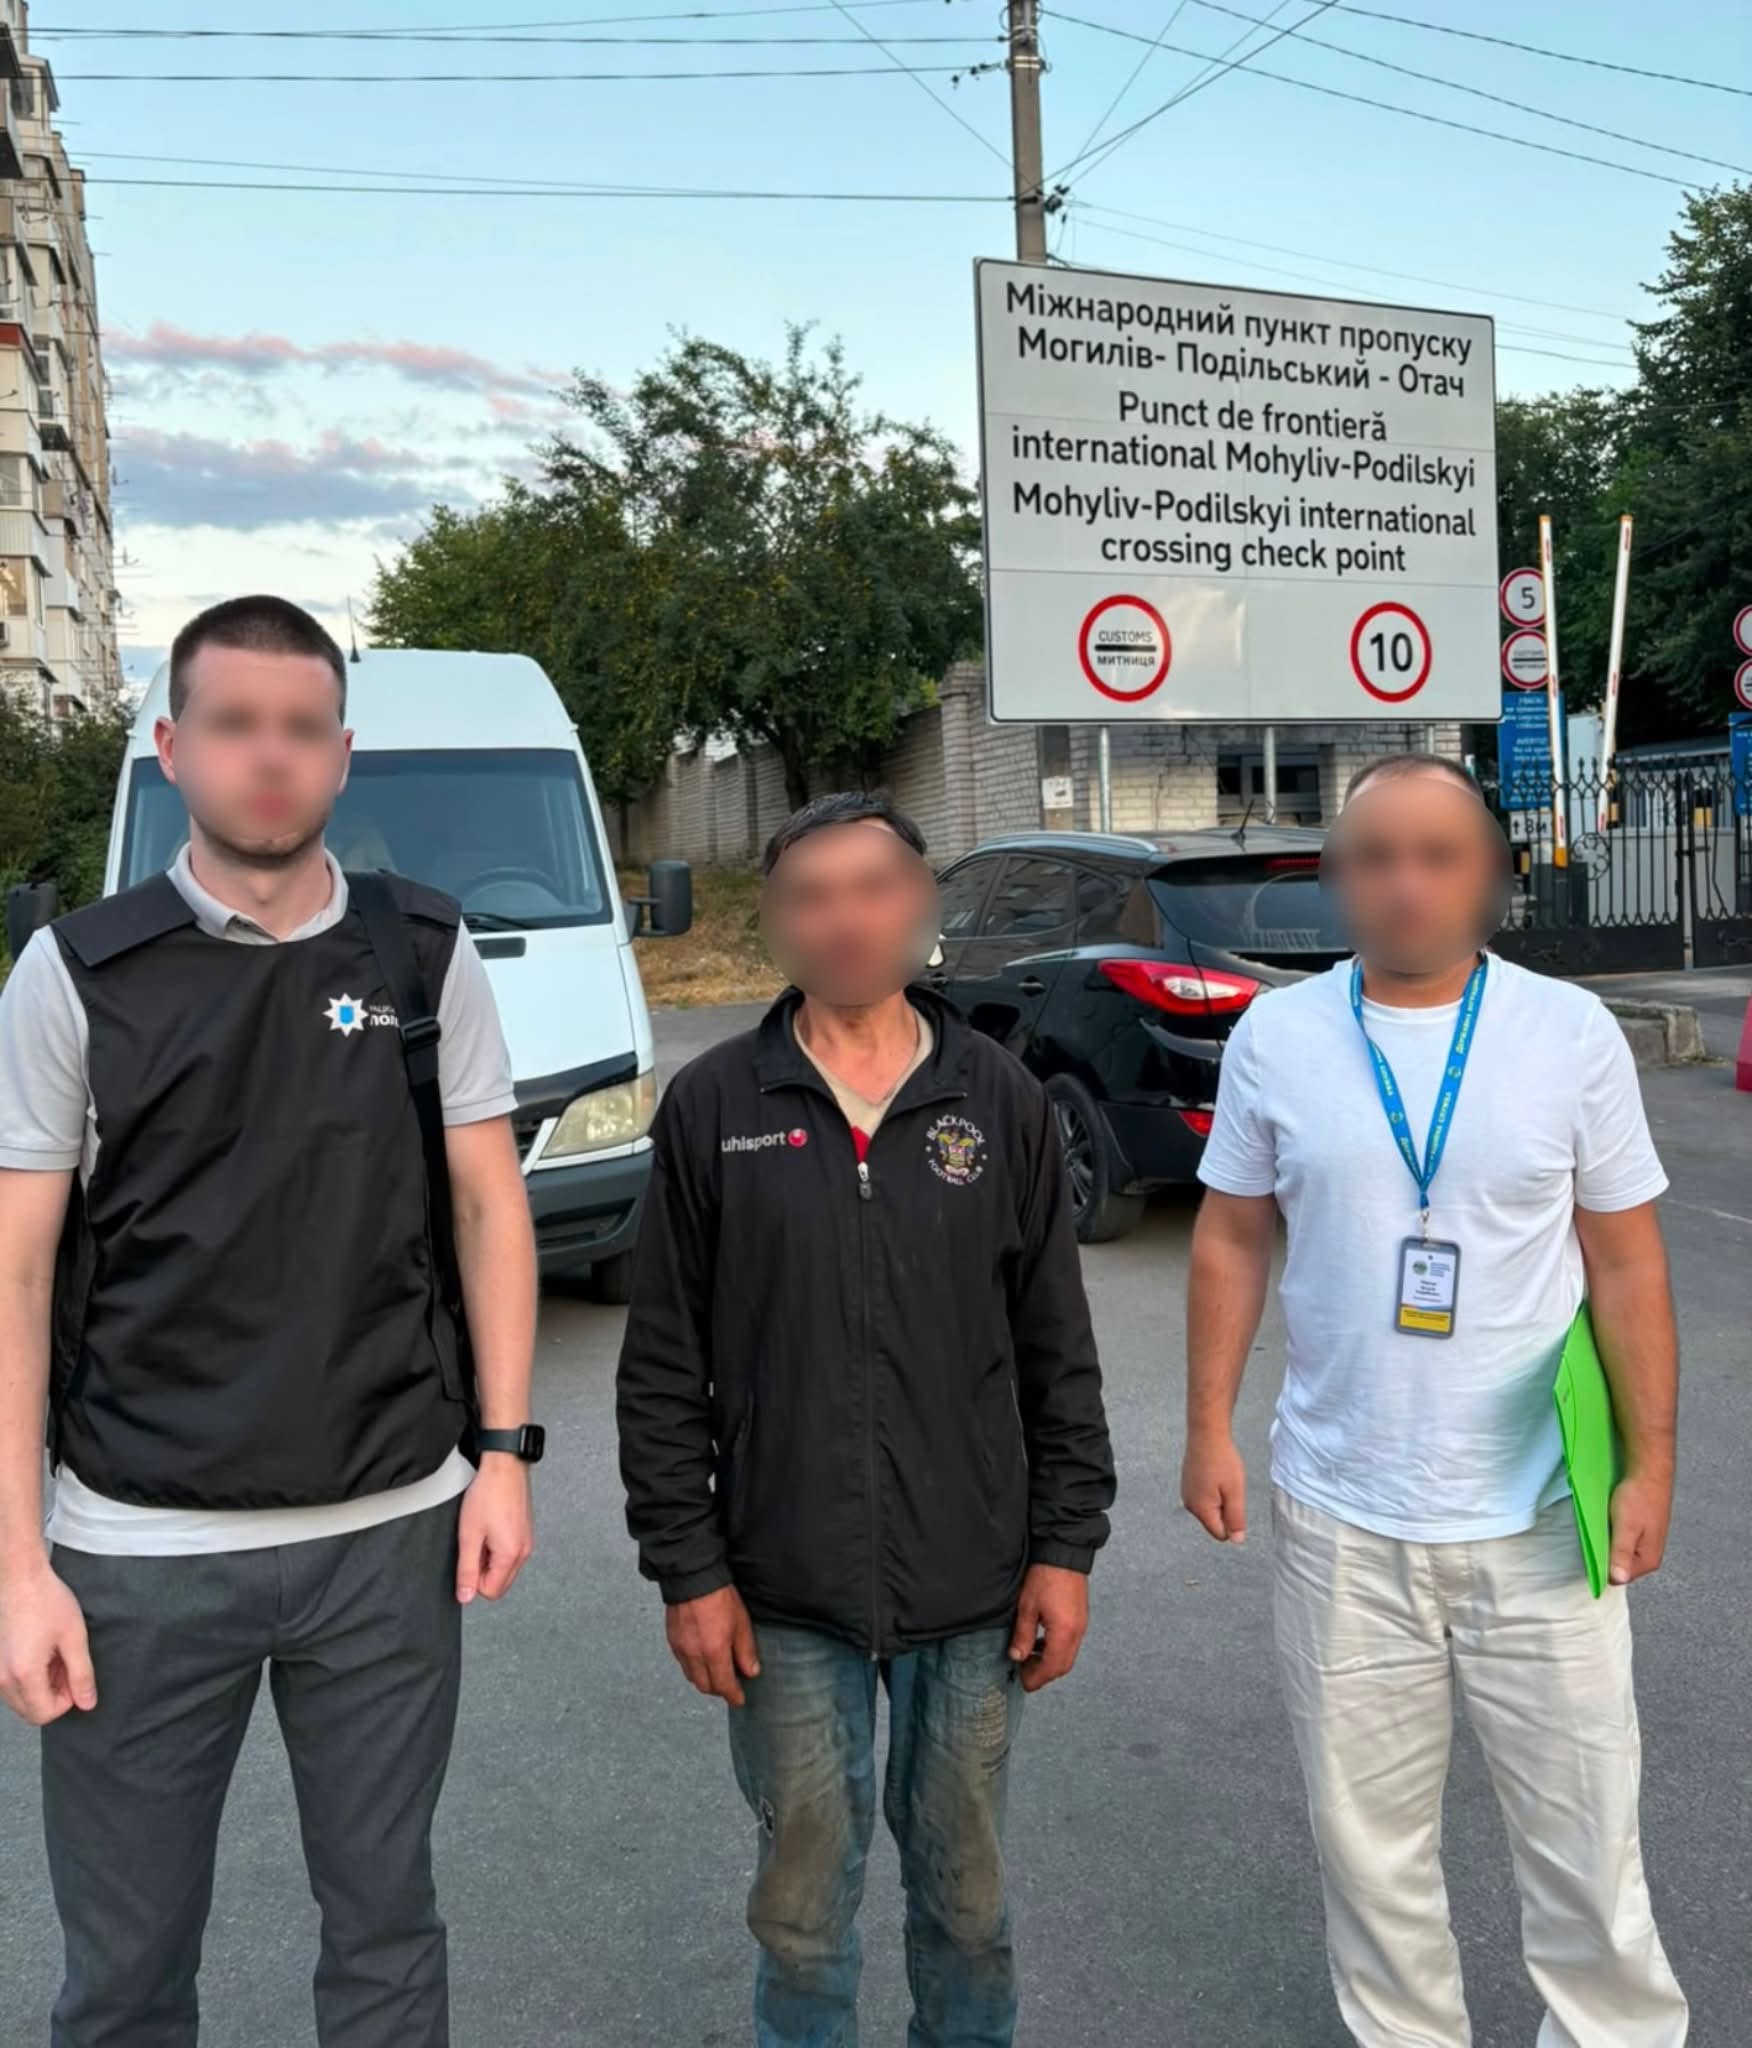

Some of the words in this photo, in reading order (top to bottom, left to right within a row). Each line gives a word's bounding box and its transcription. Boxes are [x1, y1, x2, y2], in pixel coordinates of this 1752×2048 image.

[1006, 280, 1235, 336] Міжнародний
[1245, 314, 1331, 347] пункт
[1339, 325, 1472, 366] пропуску
[1018, 325, 1167, 370] Могилів-
[1177, 341, 1370, 390] Подільський
[1398, 363, 1464, 398] Отач
[1119, 390, 1209, 428] Punct
[1217, 400, 1254, 431] de
[1262, 403, 1386, 442] frontieră
[1012, 424, 1217, 471] international
[1226, 440, 1475, 494] Mohyliv-Podilskyi
[1012, 481, 1291, 534] Mohyliv-Podilskyi
[1300, 497, 1477, 537] international
[1101, 532, 1232, 573] crossing
[1241, 536, 1327, 570] check
[1336, 540, 1407, 577] point
[1521, 586, 1536, 610] 5
[1098, 630, 1152, 642] CUSTOMS
[1370, 632, 1413, 672] 10
[1097, 655, 1155, 667] МИТНИЦЯ
[721, 1131, 786, 1152] uhlsport
